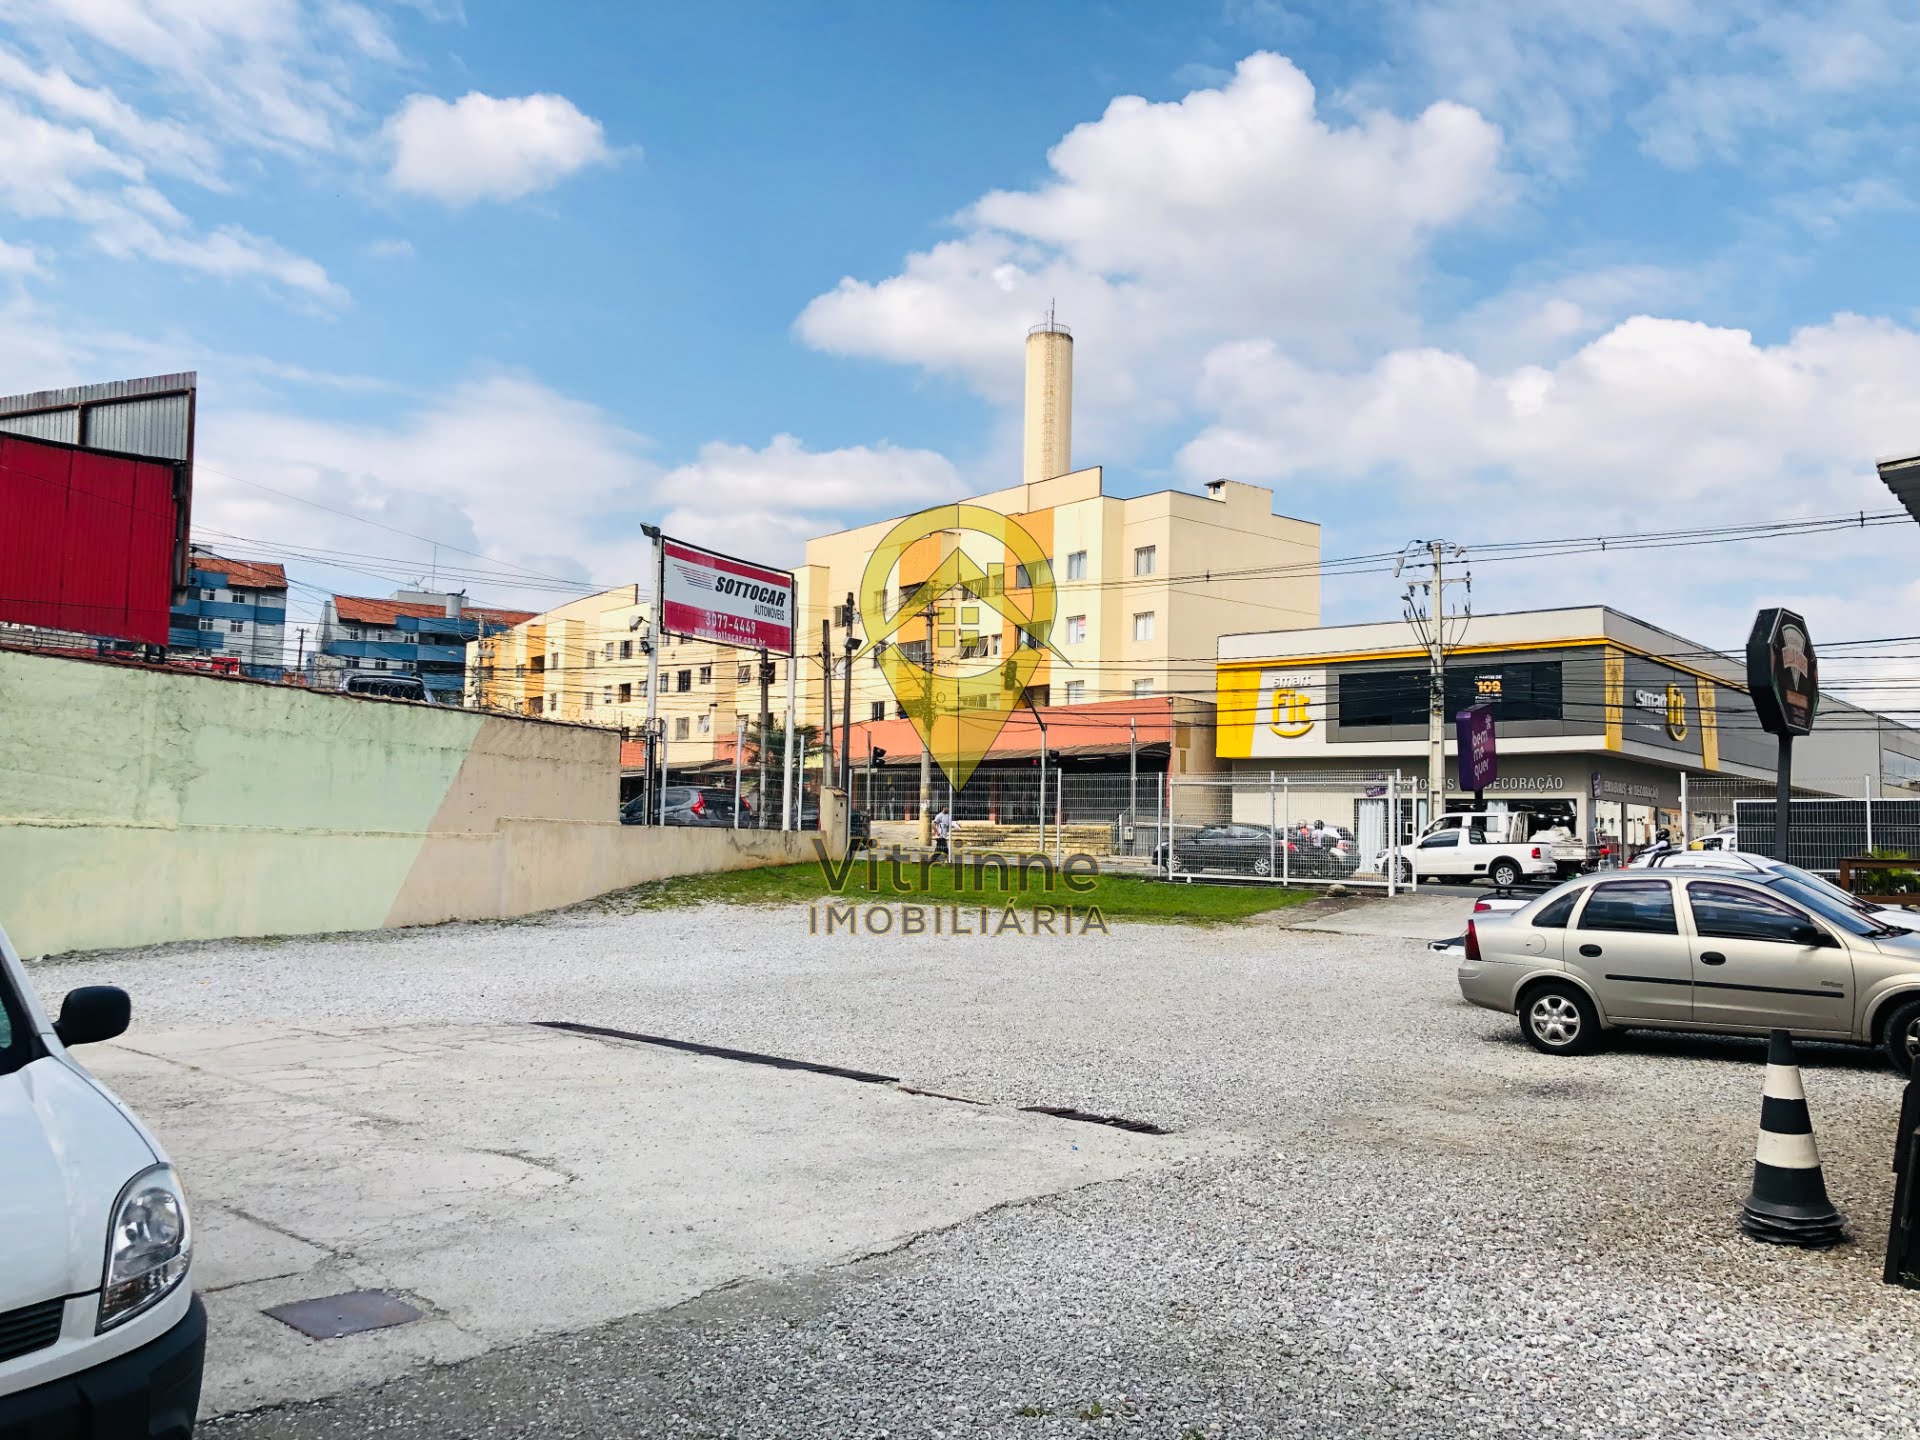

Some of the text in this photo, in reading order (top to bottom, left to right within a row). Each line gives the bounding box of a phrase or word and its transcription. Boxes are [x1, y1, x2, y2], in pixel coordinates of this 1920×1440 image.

[715, 576, 786, 607] SOTTOCAR
[705, 611, 756, 635] 3077-4449
[1273, 676, 1311, 687] smart
[1272, 689, 1310, 724] fit
[1668, 683, 1686, 725] fit
[1472, 730, 1488, 747] bem
[1474, 746, 1484, 761] me
[1474, 758, 1489, 780] quer
